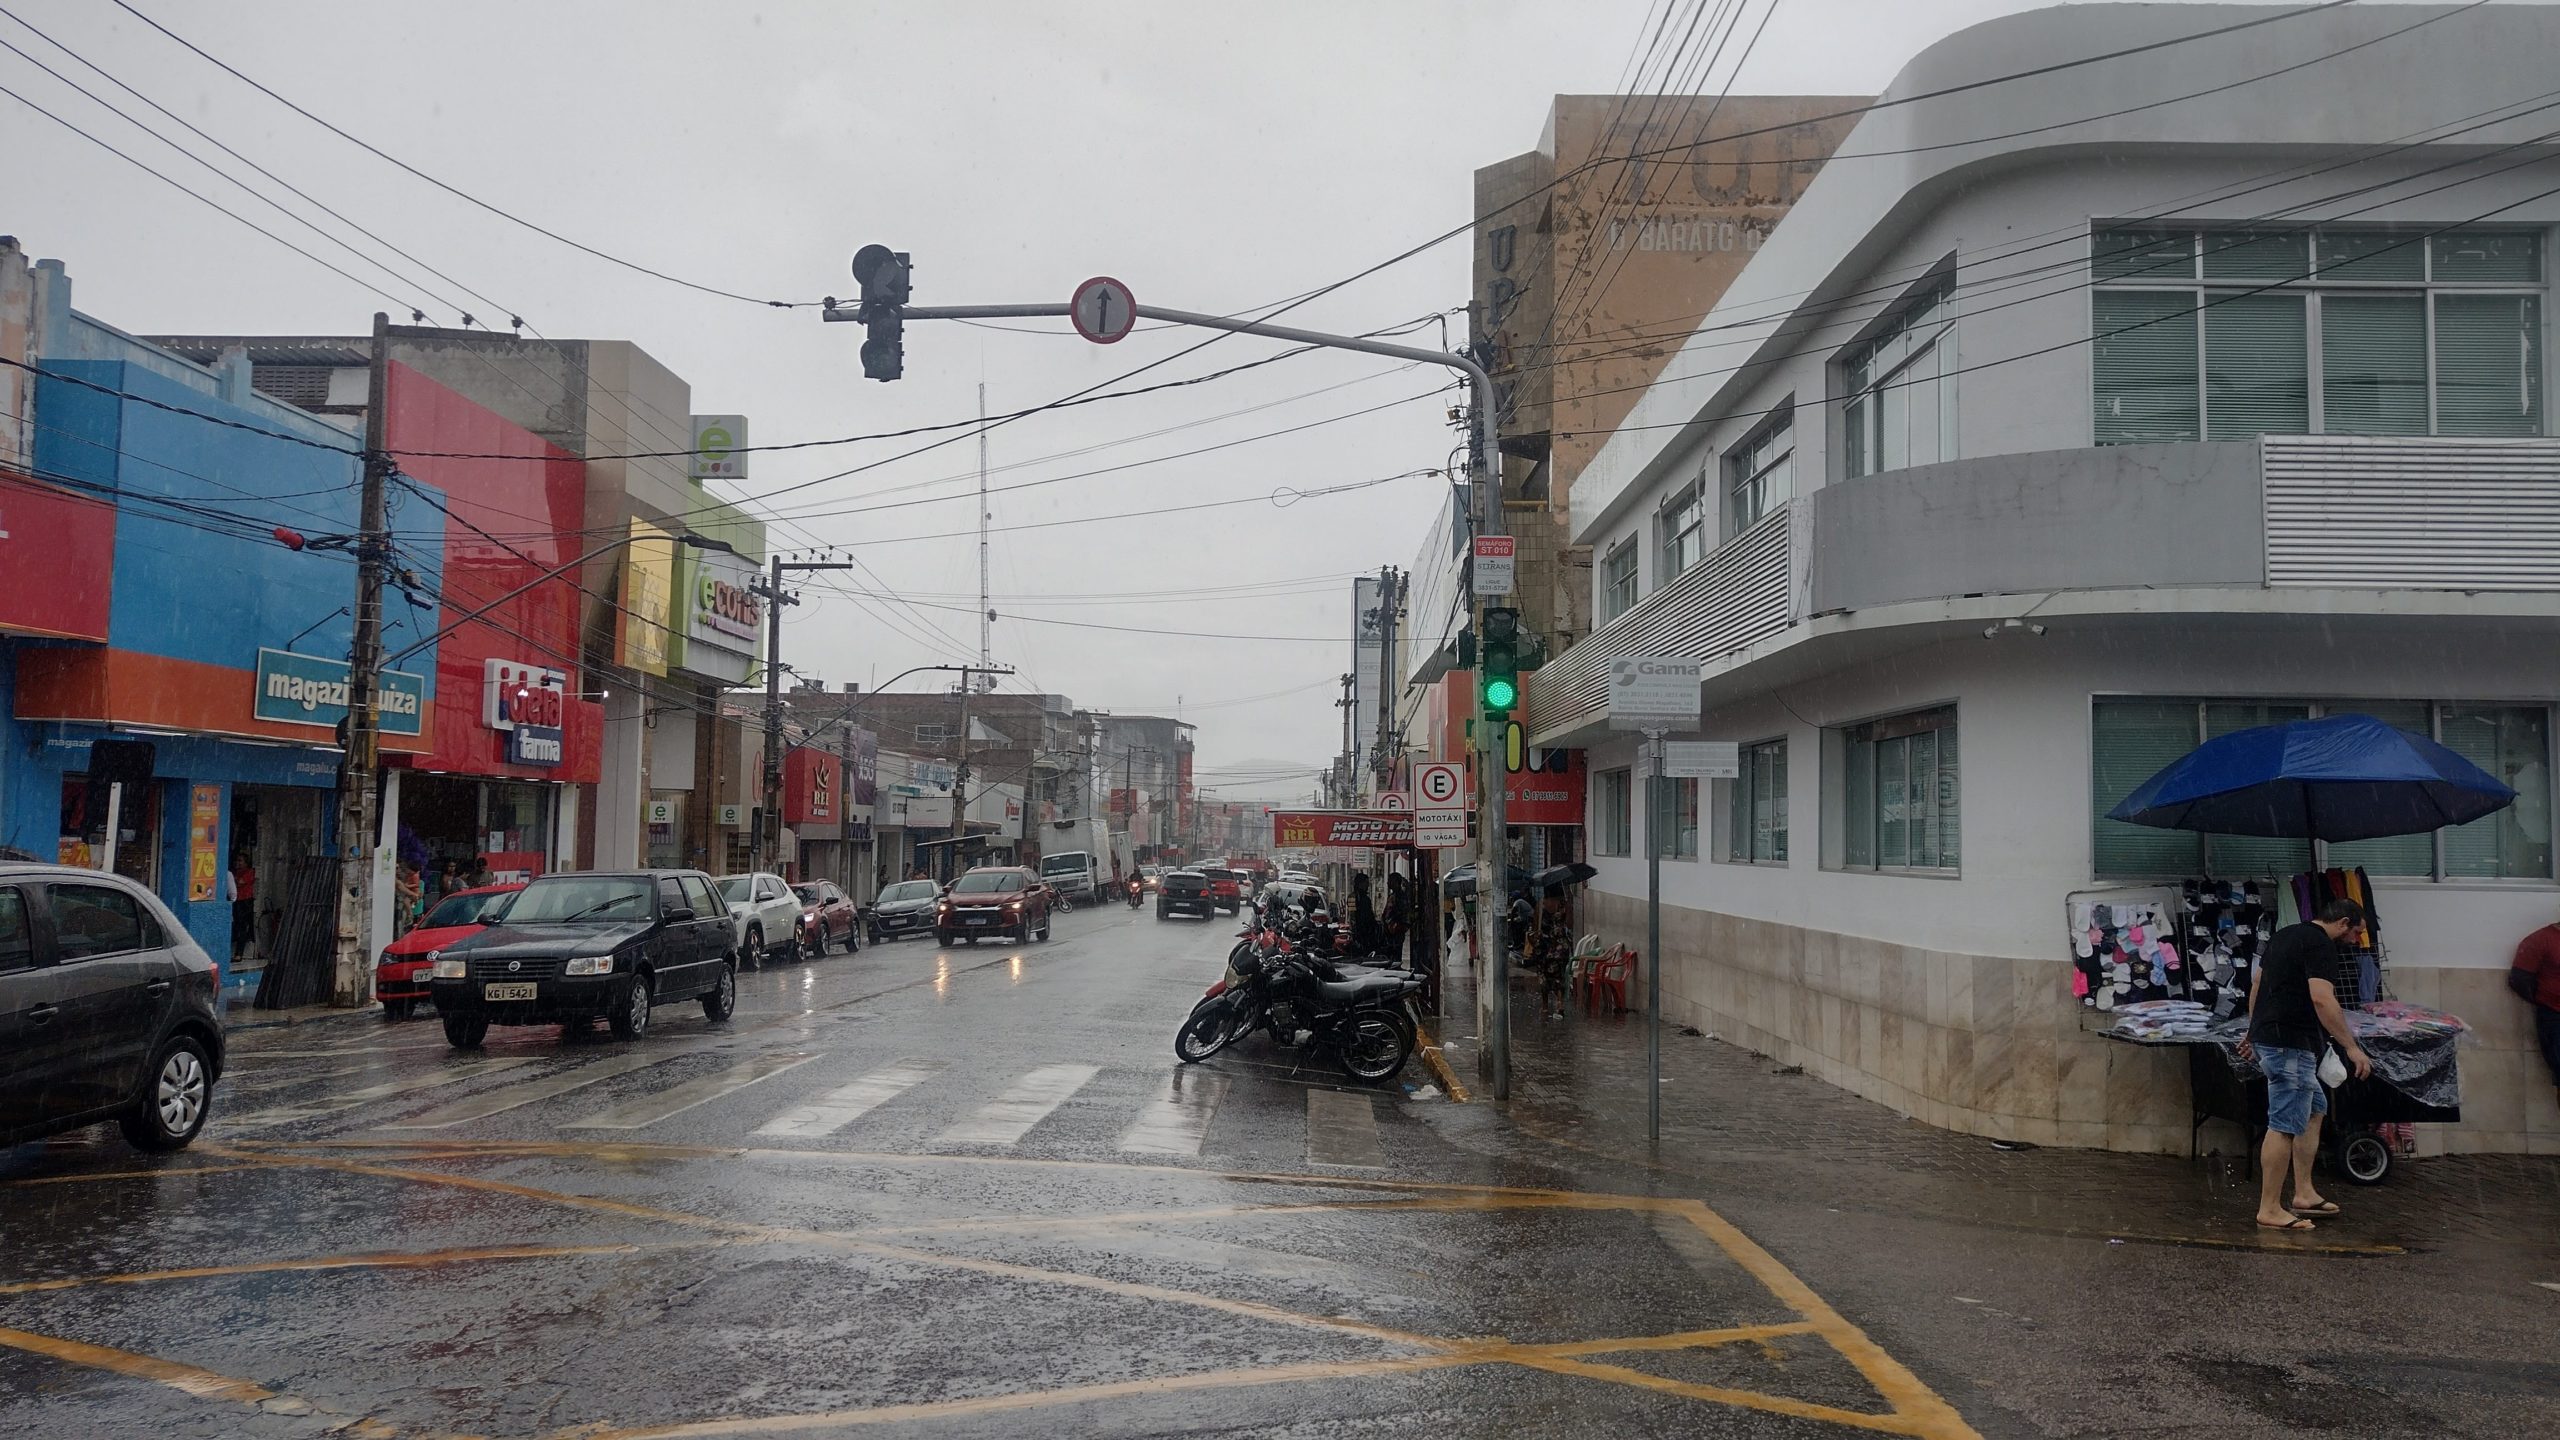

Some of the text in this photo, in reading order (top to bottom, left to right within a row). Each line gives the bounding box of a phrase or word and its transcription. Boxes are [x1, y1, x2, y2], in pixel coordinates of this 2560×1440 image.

[1481, 546, 1509, 554] ST 010
[1637, 661, 1700, 676] Gama
[519, 728, 560, 762] farma
[296, 761, 338, 774] magalu.c
[1433, 775, 1446, 793] E
[813, 790, 829, 805] REI
[1418, 813, 1462, 823] MOTOTÁXI
[1333, 821, 1383, 831] MOTO
[1283, 828, 1316, 841] REI
